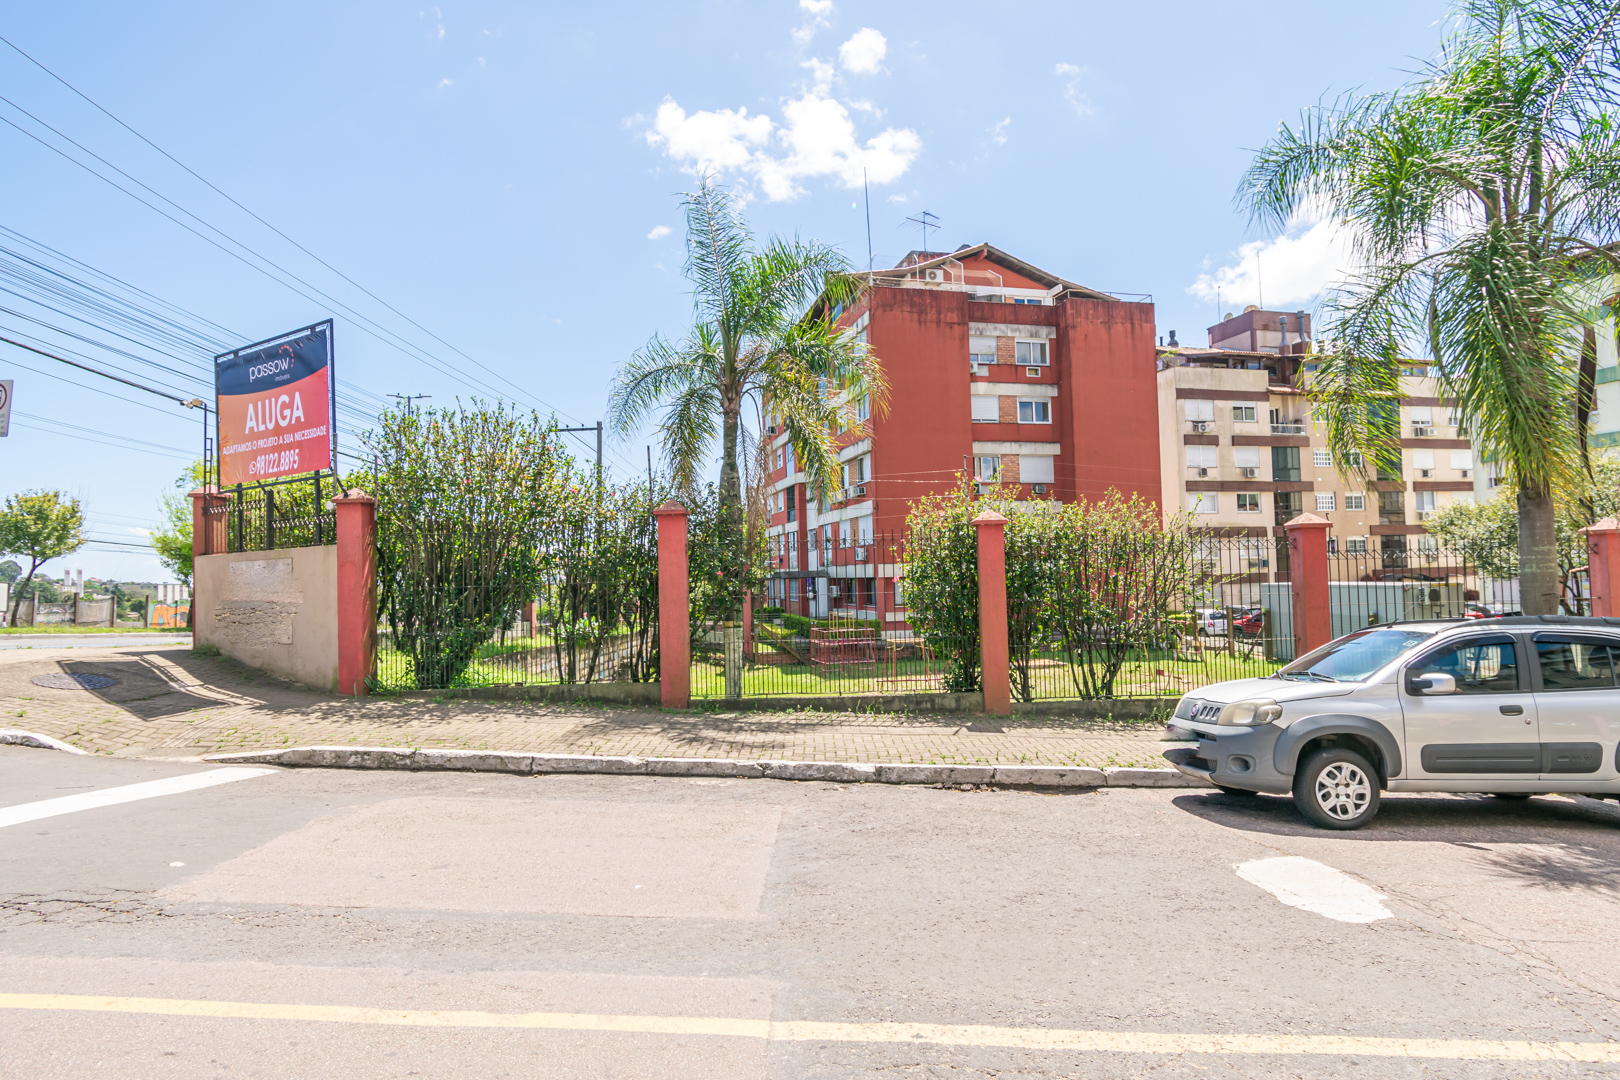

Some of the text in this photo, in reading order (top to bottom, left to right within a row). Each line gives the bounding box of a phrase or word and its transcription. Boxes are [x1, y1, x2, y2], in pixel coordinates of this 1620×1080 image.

[249, 357, 289, 383] passow
[245, 391, 304, 434] ALUGA
[222, 425, 327, 455] ADAPTAMOS O PROJETO A SUA NECESSIDADE
[256, 449, 299, 475] 98122.8895
